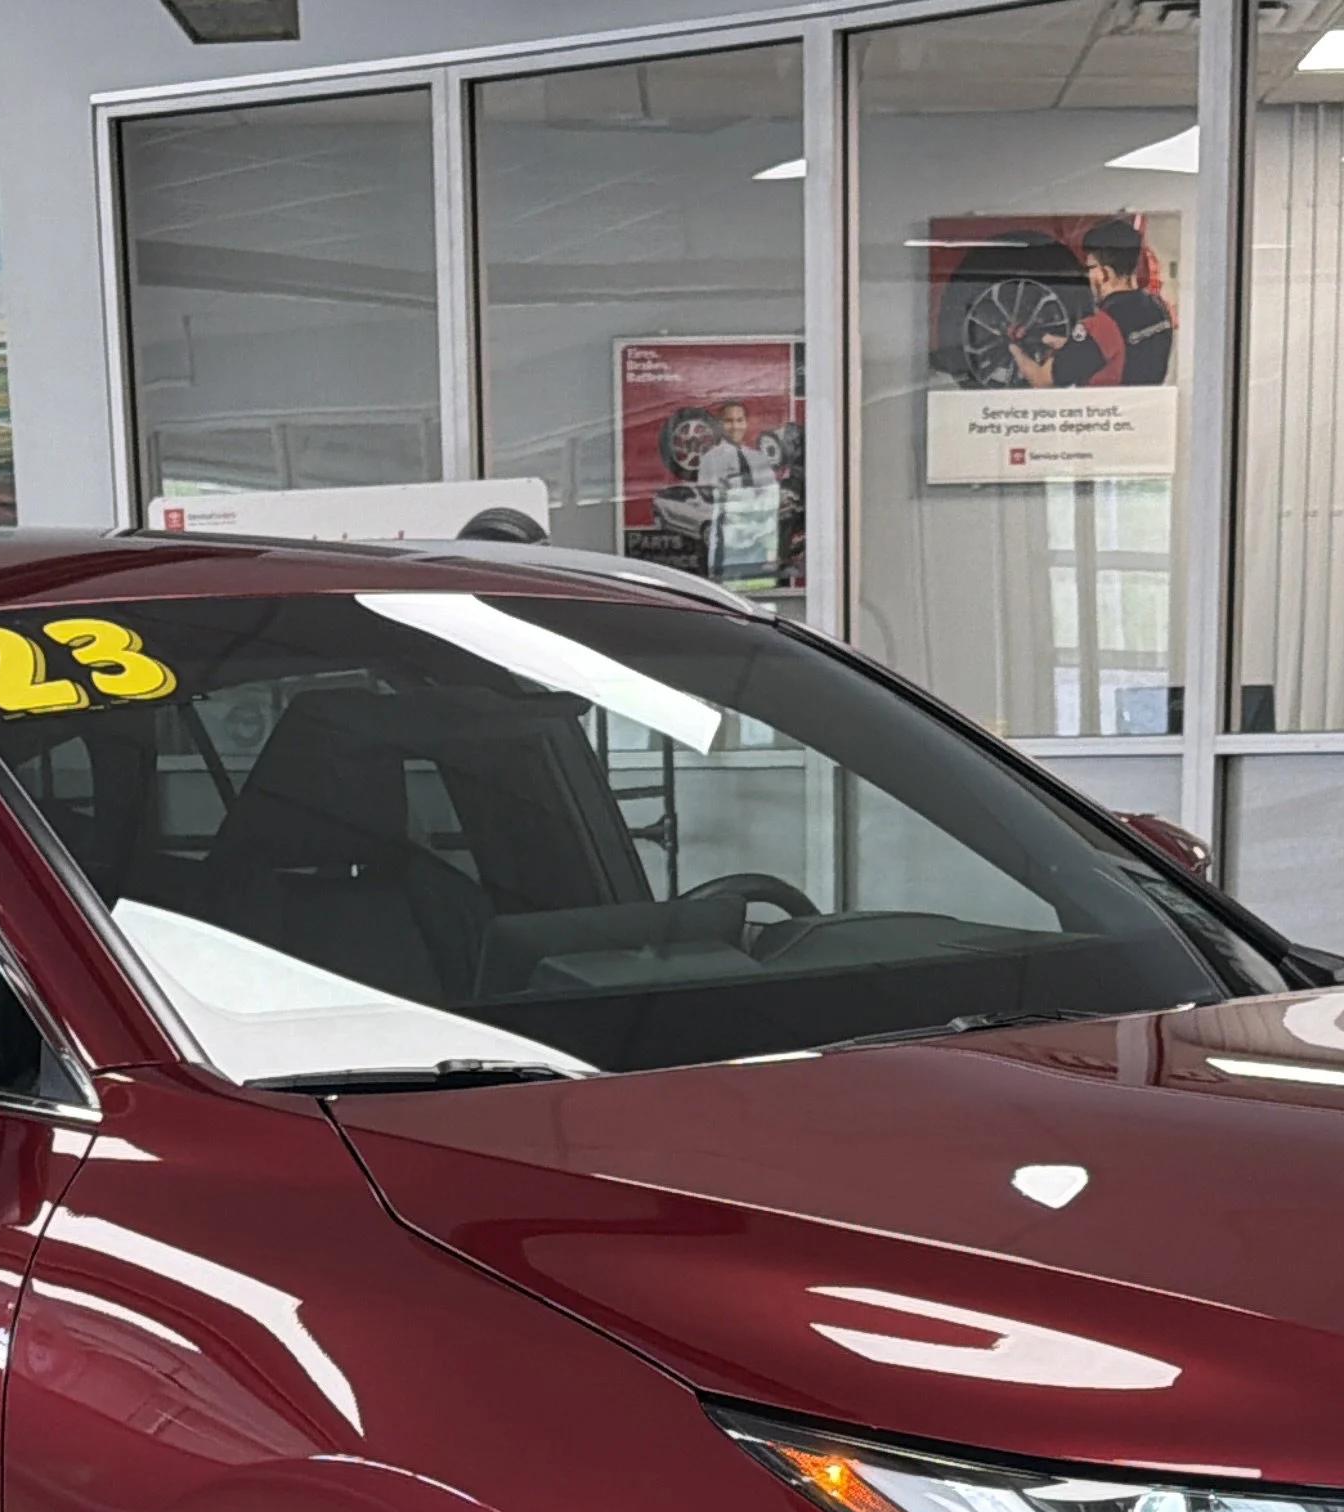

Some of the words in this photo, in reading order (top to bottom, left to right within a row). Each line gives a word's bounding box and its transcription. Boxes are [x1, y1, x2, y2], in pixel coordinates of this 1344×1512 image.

[982, 406, 1029, 420] Service
[1032, 409, 1056, 421] you
[1059, 408, 1084, 419] can
[1086, 406, 1122, 418] trust.
[968, 421, 1002, 434] Parts
[1005, 424, 1030, 437] you
[1032, 422, 1056, 434] can
[1059, 419, 1111, 435] depend
[1113, 421, 1135, 433] on.
